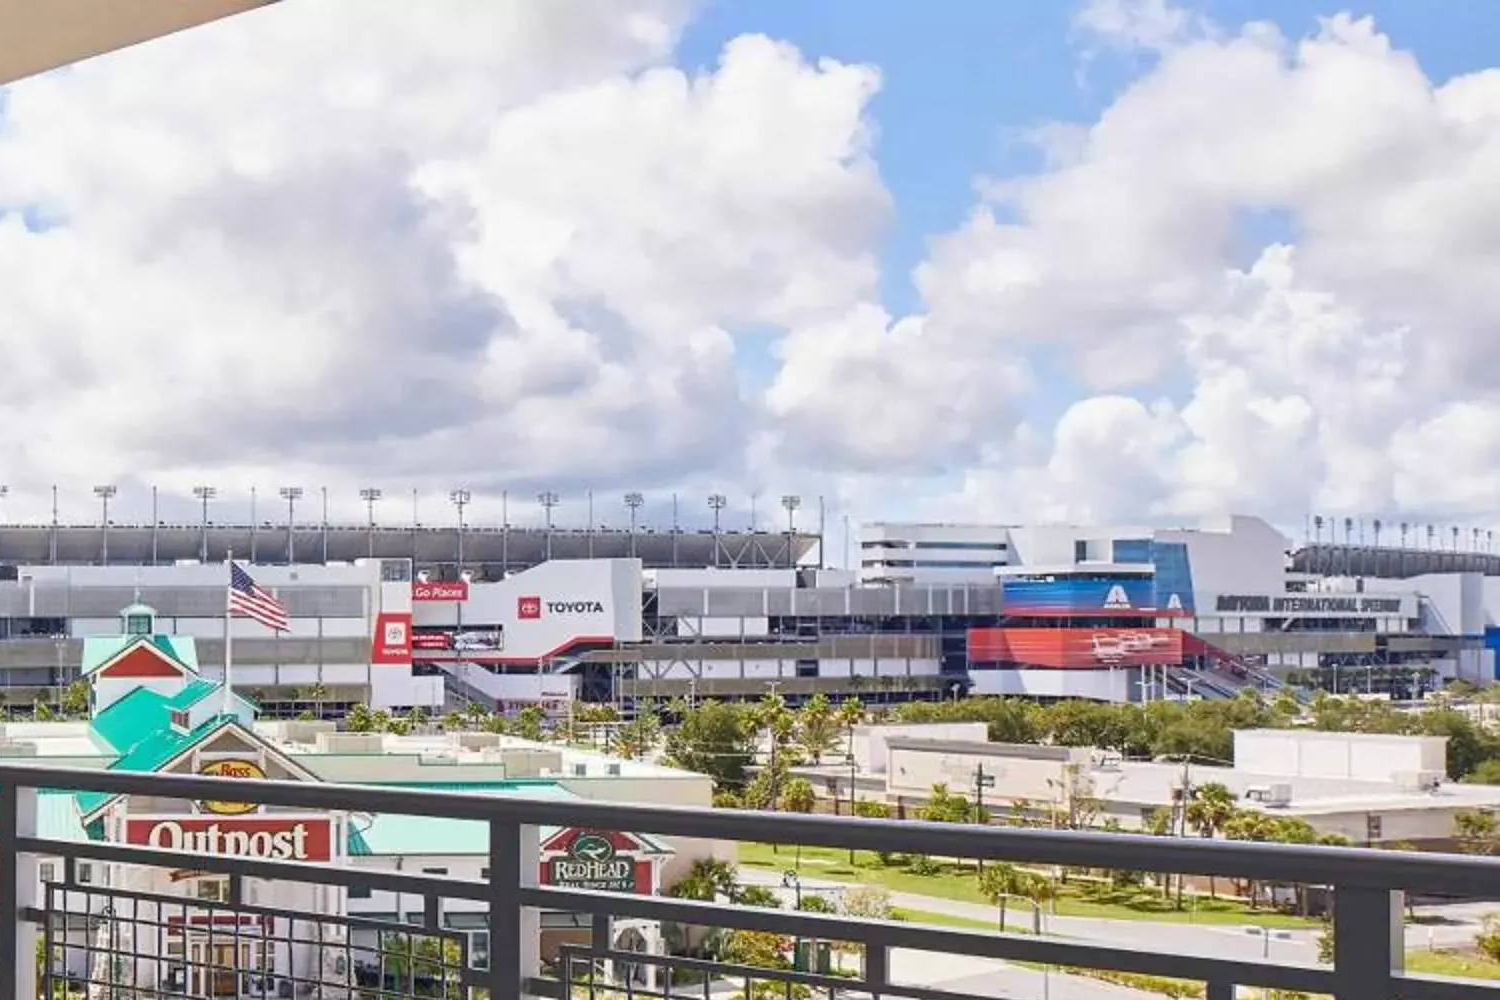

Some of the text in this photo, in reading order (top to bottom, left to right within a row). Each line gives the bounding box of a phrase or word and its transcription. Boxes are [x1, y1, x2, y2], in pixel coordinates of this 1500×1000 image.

[415, 587, 463, 598] Go Places
[546, 602, 603, 613] TOYOTA
[1273, 597, 1357, 612] INTERNATIONAL
[150, 821, 309, 860] Outpost
